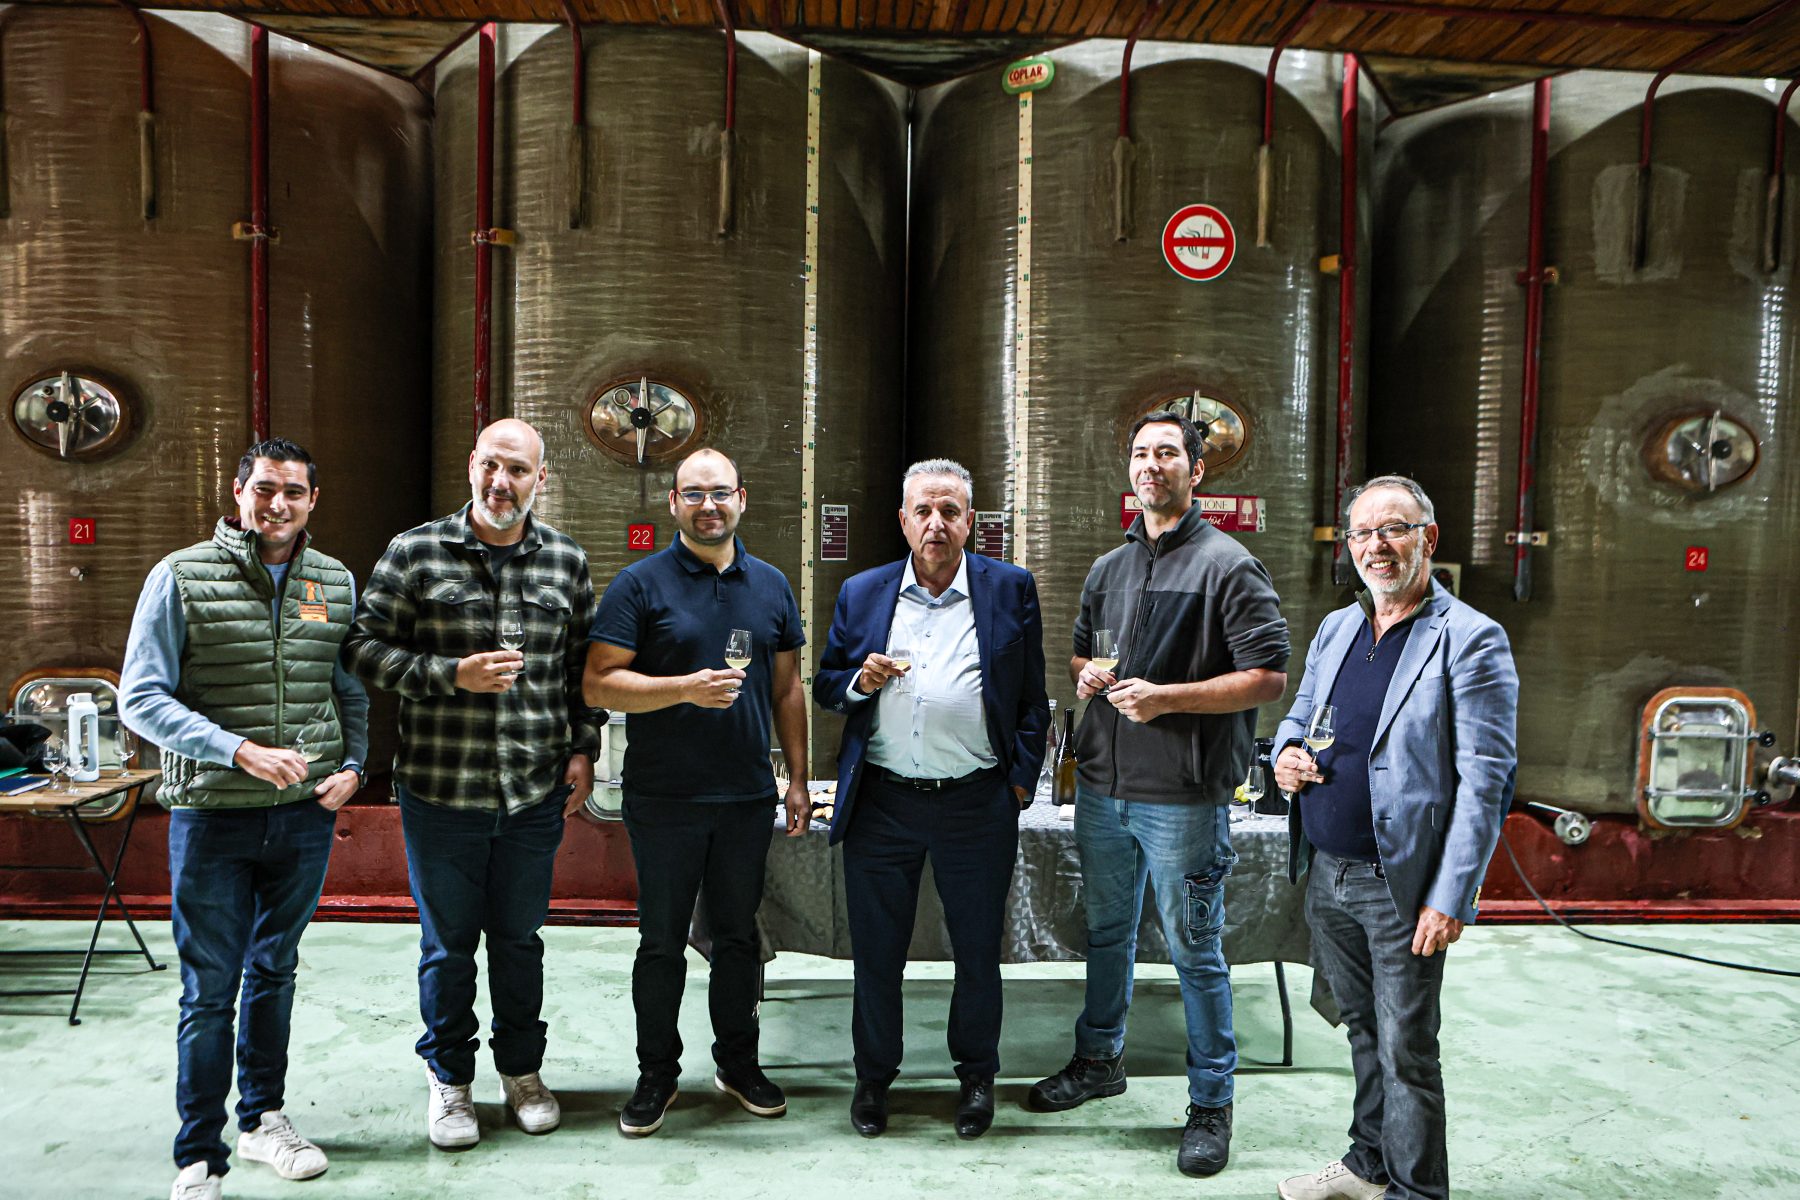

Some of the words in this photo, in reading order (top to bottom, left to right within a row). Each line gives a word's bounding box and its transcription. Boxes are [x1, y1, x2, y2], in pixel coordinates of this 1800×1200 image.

[1009, 66, 1043, 82] COPLAR
[74, 523, 89, 539] 21
[632, 529, 651, 545] 22
[1688, 550, 1706, 567] 24
